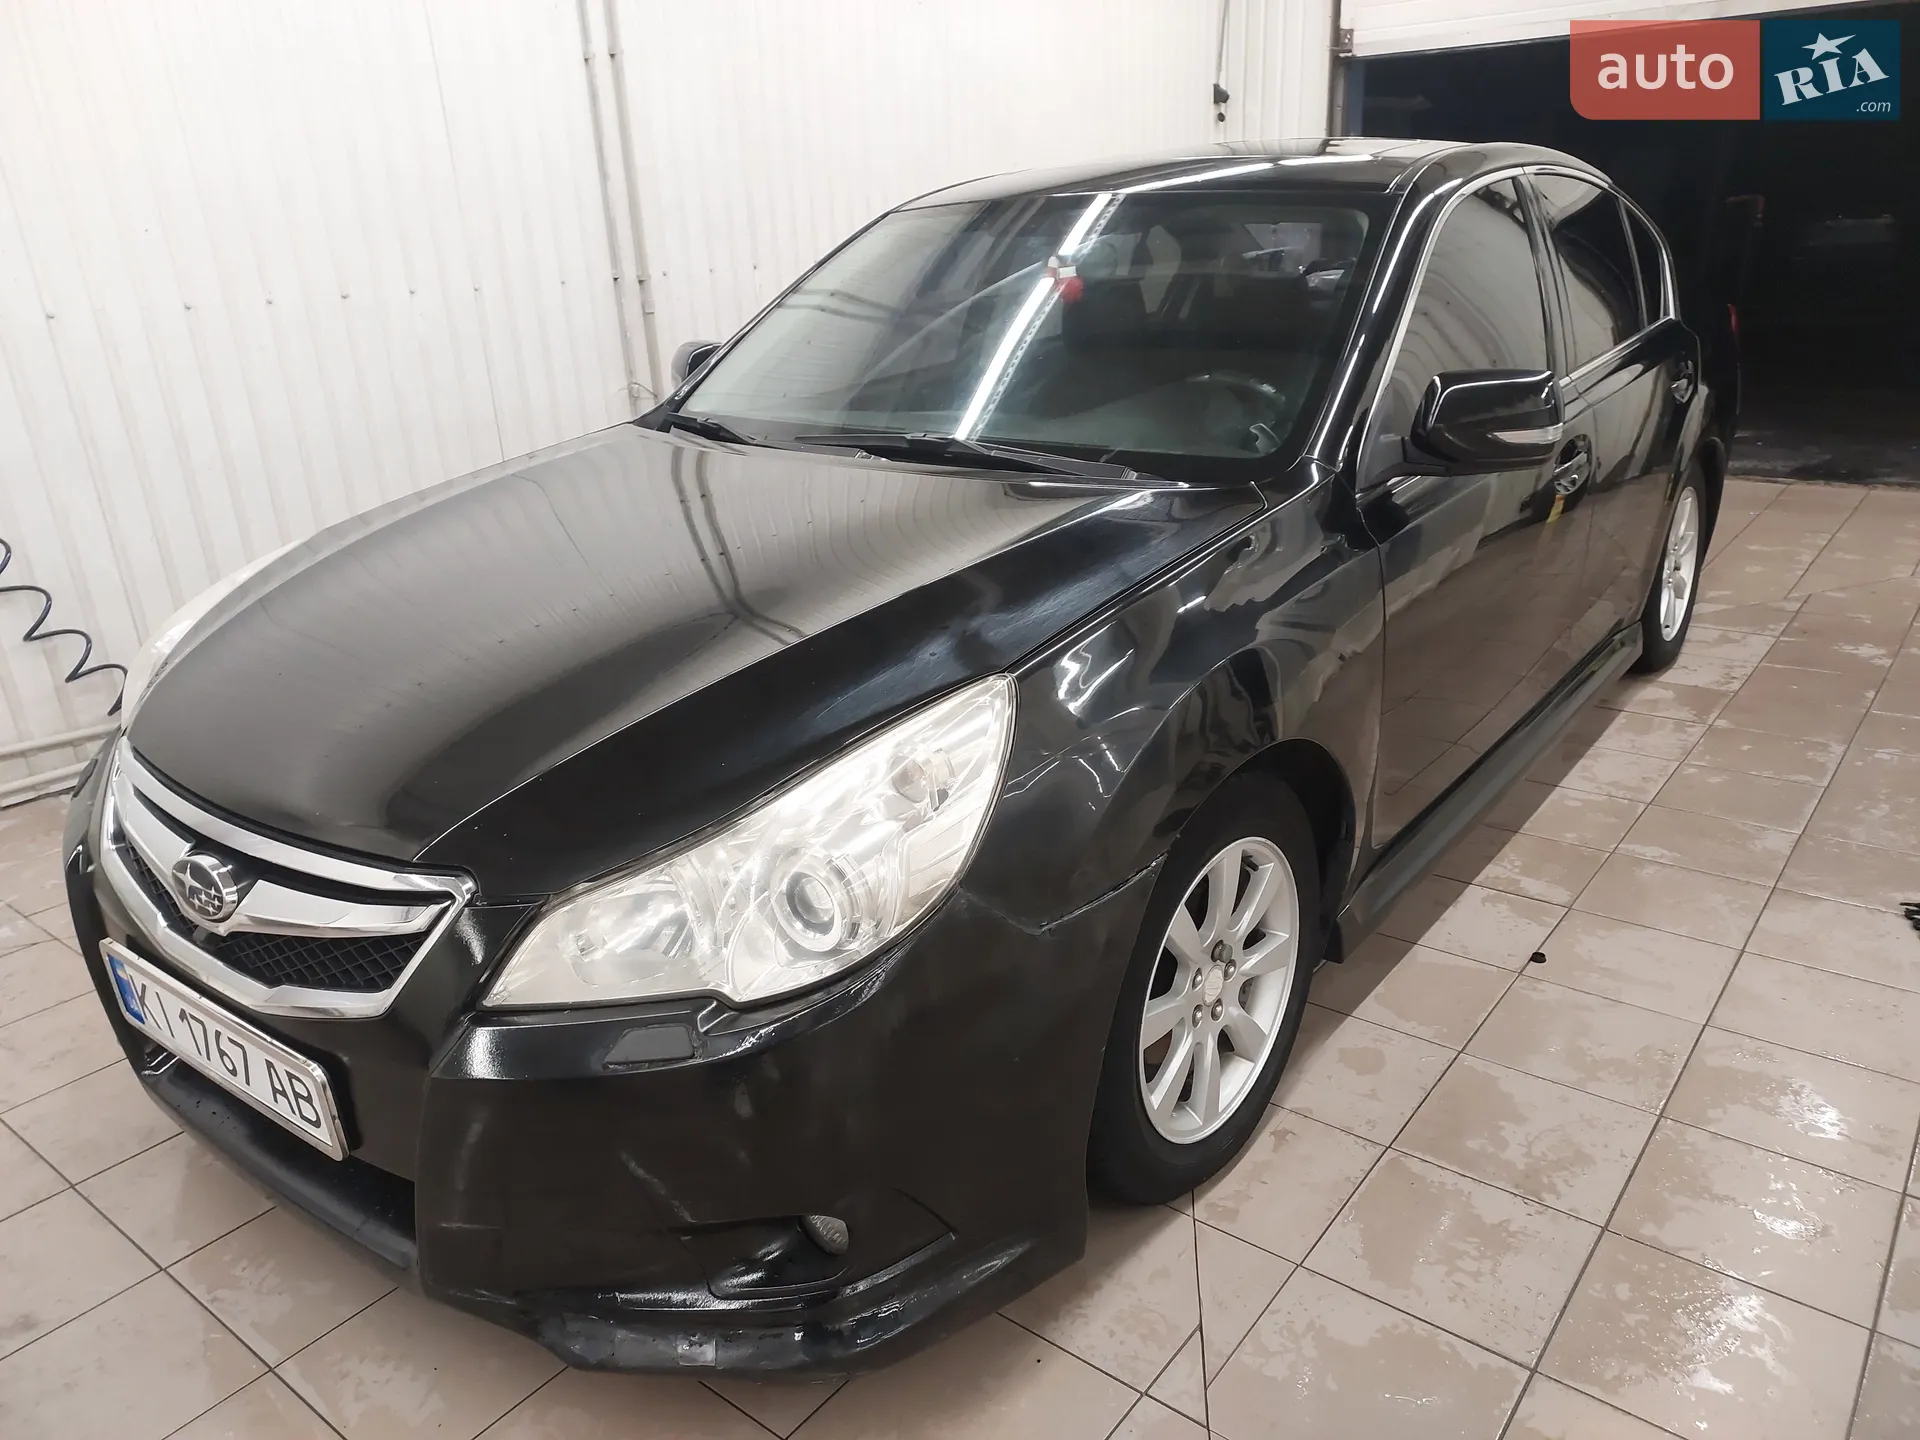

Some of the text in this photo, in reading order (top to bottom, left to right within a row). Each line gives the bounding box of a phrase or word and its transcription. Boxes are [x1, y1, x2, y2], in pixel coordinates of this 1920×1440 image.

[128, 972, 322, 1130] KI 1767 AB
